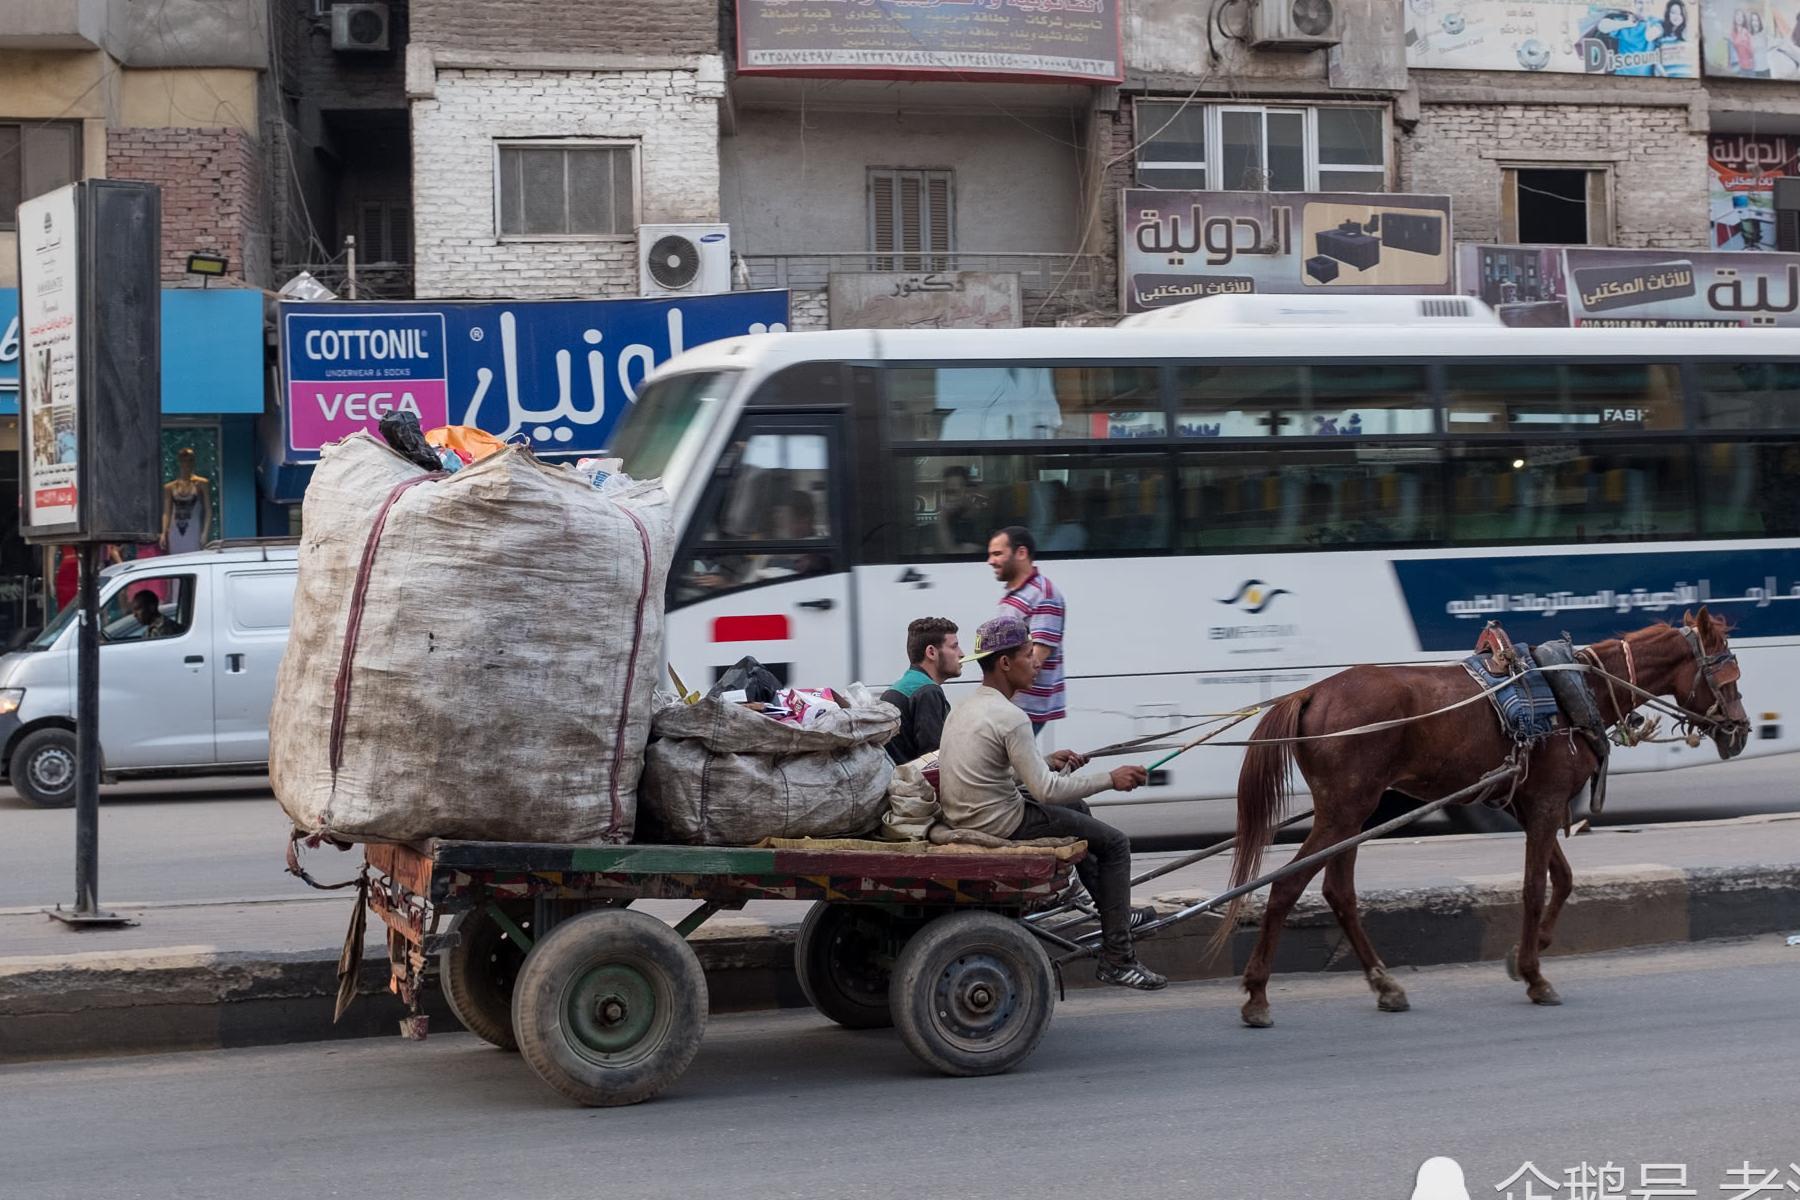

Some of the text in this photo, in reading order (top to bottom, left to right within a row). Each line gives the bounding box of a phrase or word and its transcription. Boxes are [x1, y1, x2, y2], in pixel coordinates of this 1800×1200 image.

[1136, 204, 1292, 265] الدولية
[890, 275, 965, 298] دكتور
[305, 329, 429, 360] COTTONIL
[325, 368, 374, 378] UNDERWEAR
[383, 368, 411, 376] SOCKS
[315, 392, 423, 421] VEGA
